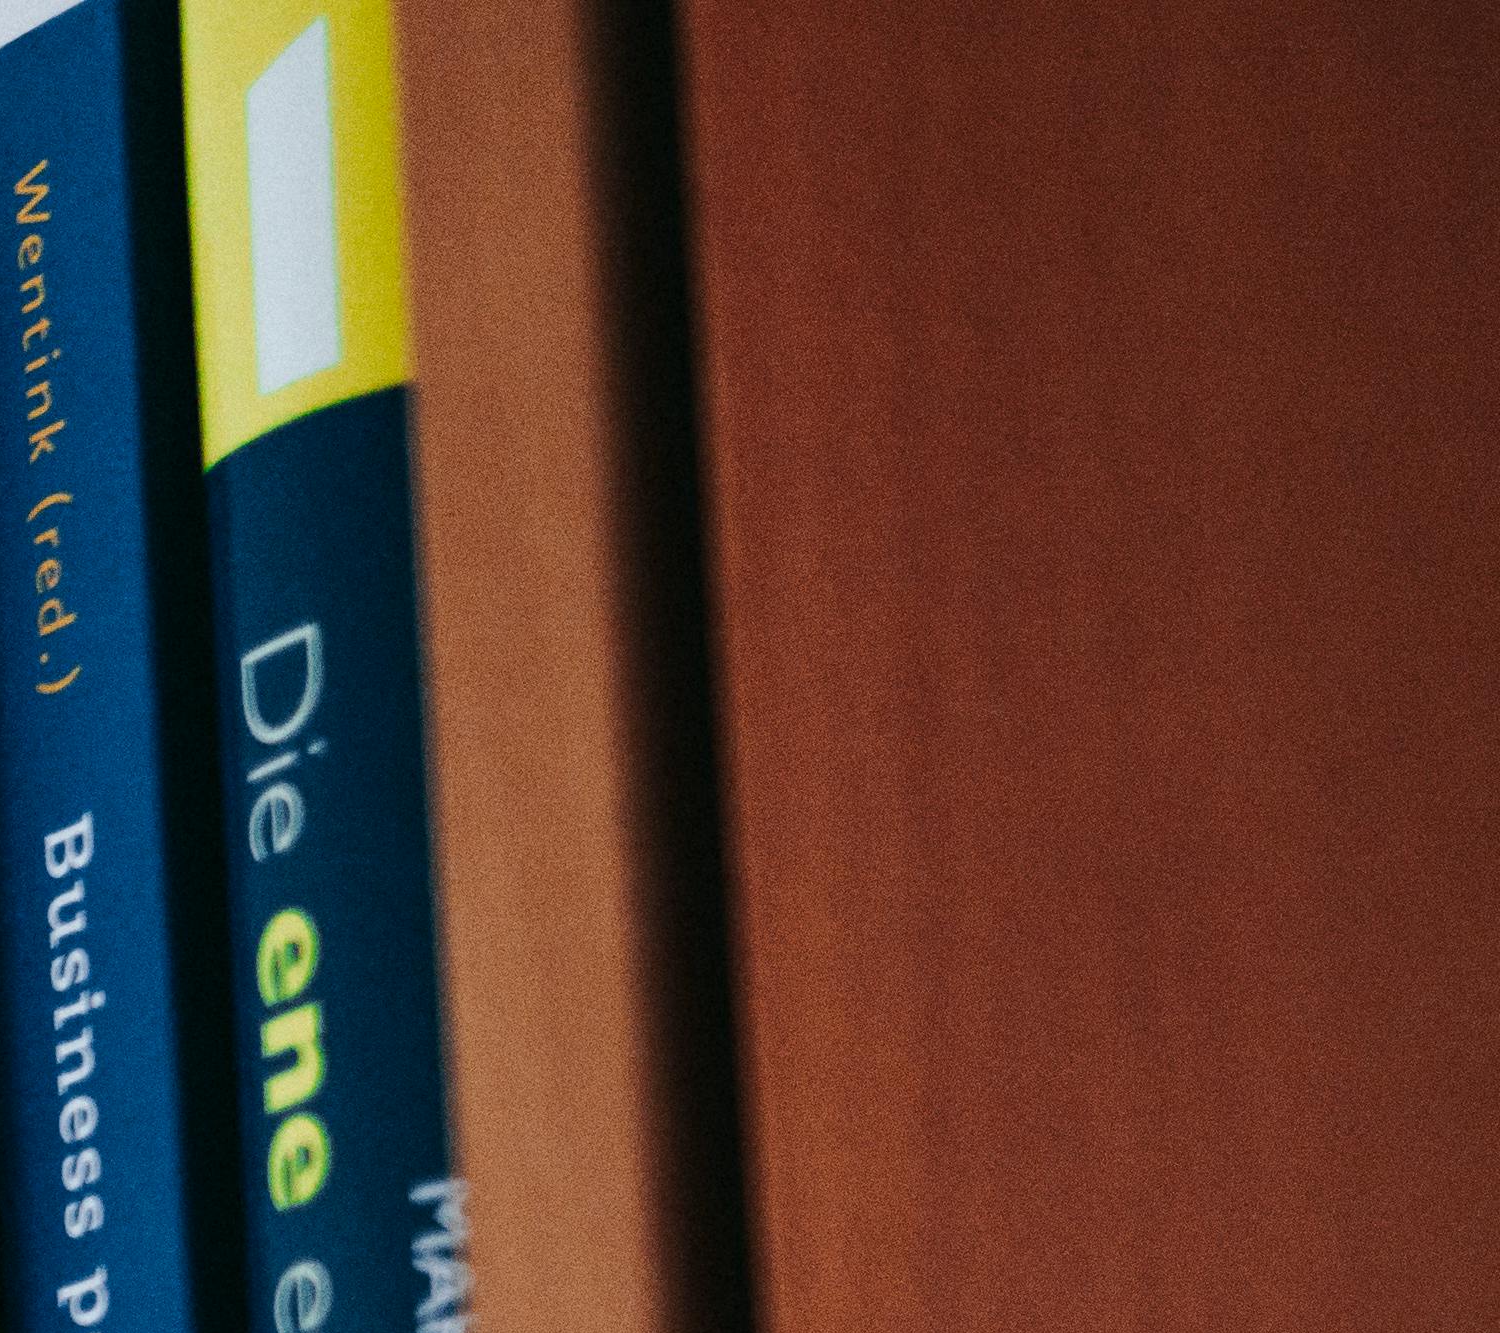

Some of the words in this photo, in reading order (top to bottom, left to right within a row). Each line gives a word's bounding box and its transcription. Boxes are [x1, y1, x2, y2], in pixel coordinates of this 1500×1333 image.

[11, 158, 69, 465] Wentink
[24, 489, 84, 697] (red.)
[240, 620, 326, 865] Die
[43, 810, 107, 1241] Business
[254, 906, 332, 1214] ene
